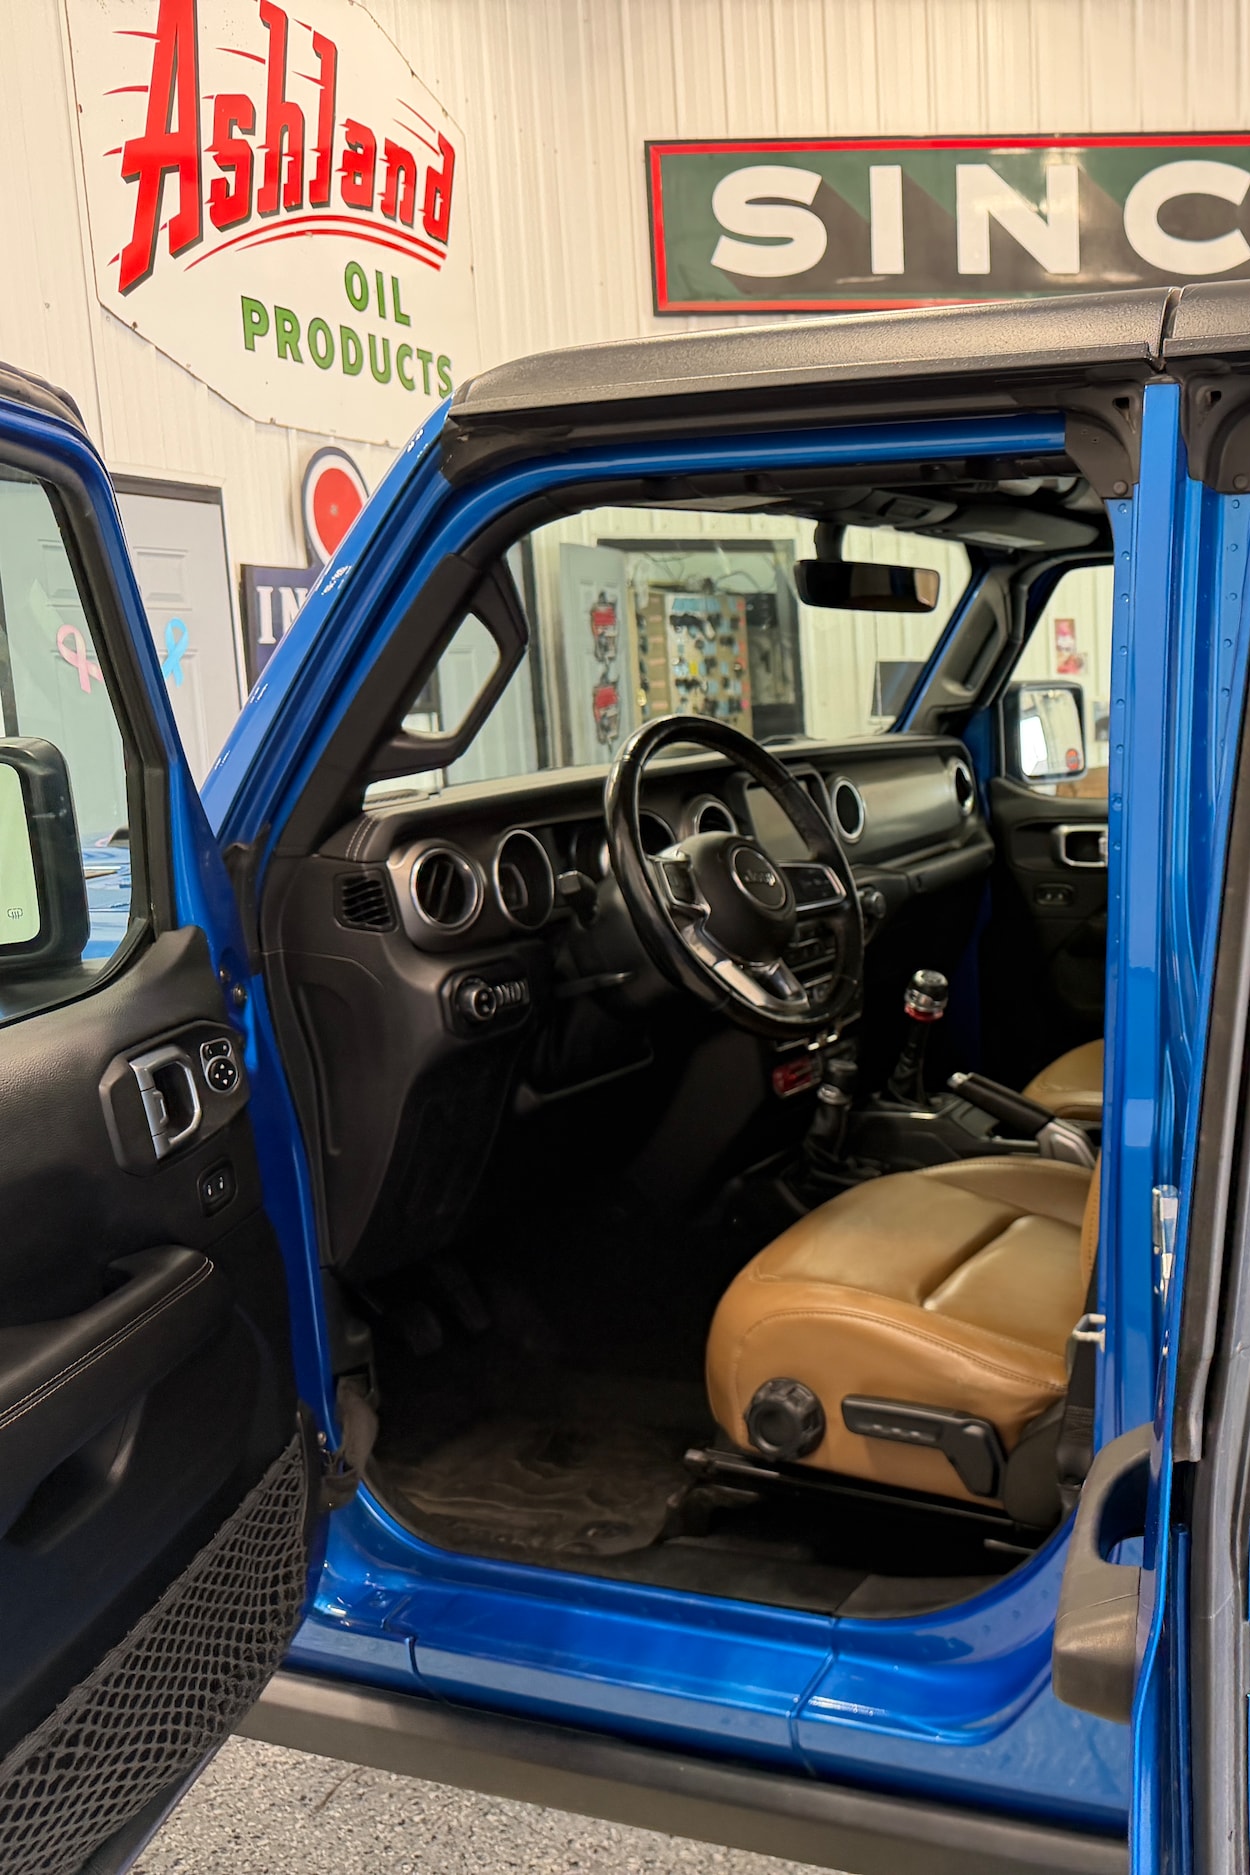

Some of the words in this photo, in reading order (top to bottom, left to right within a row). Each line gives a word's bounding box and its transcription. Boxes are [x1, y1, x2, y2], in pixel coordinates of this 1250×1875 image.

[117, 0, 456, 296] Ashland
[344, 261, 411, 327] OIL
[241, 295, 453, 399] PRODUCTS
